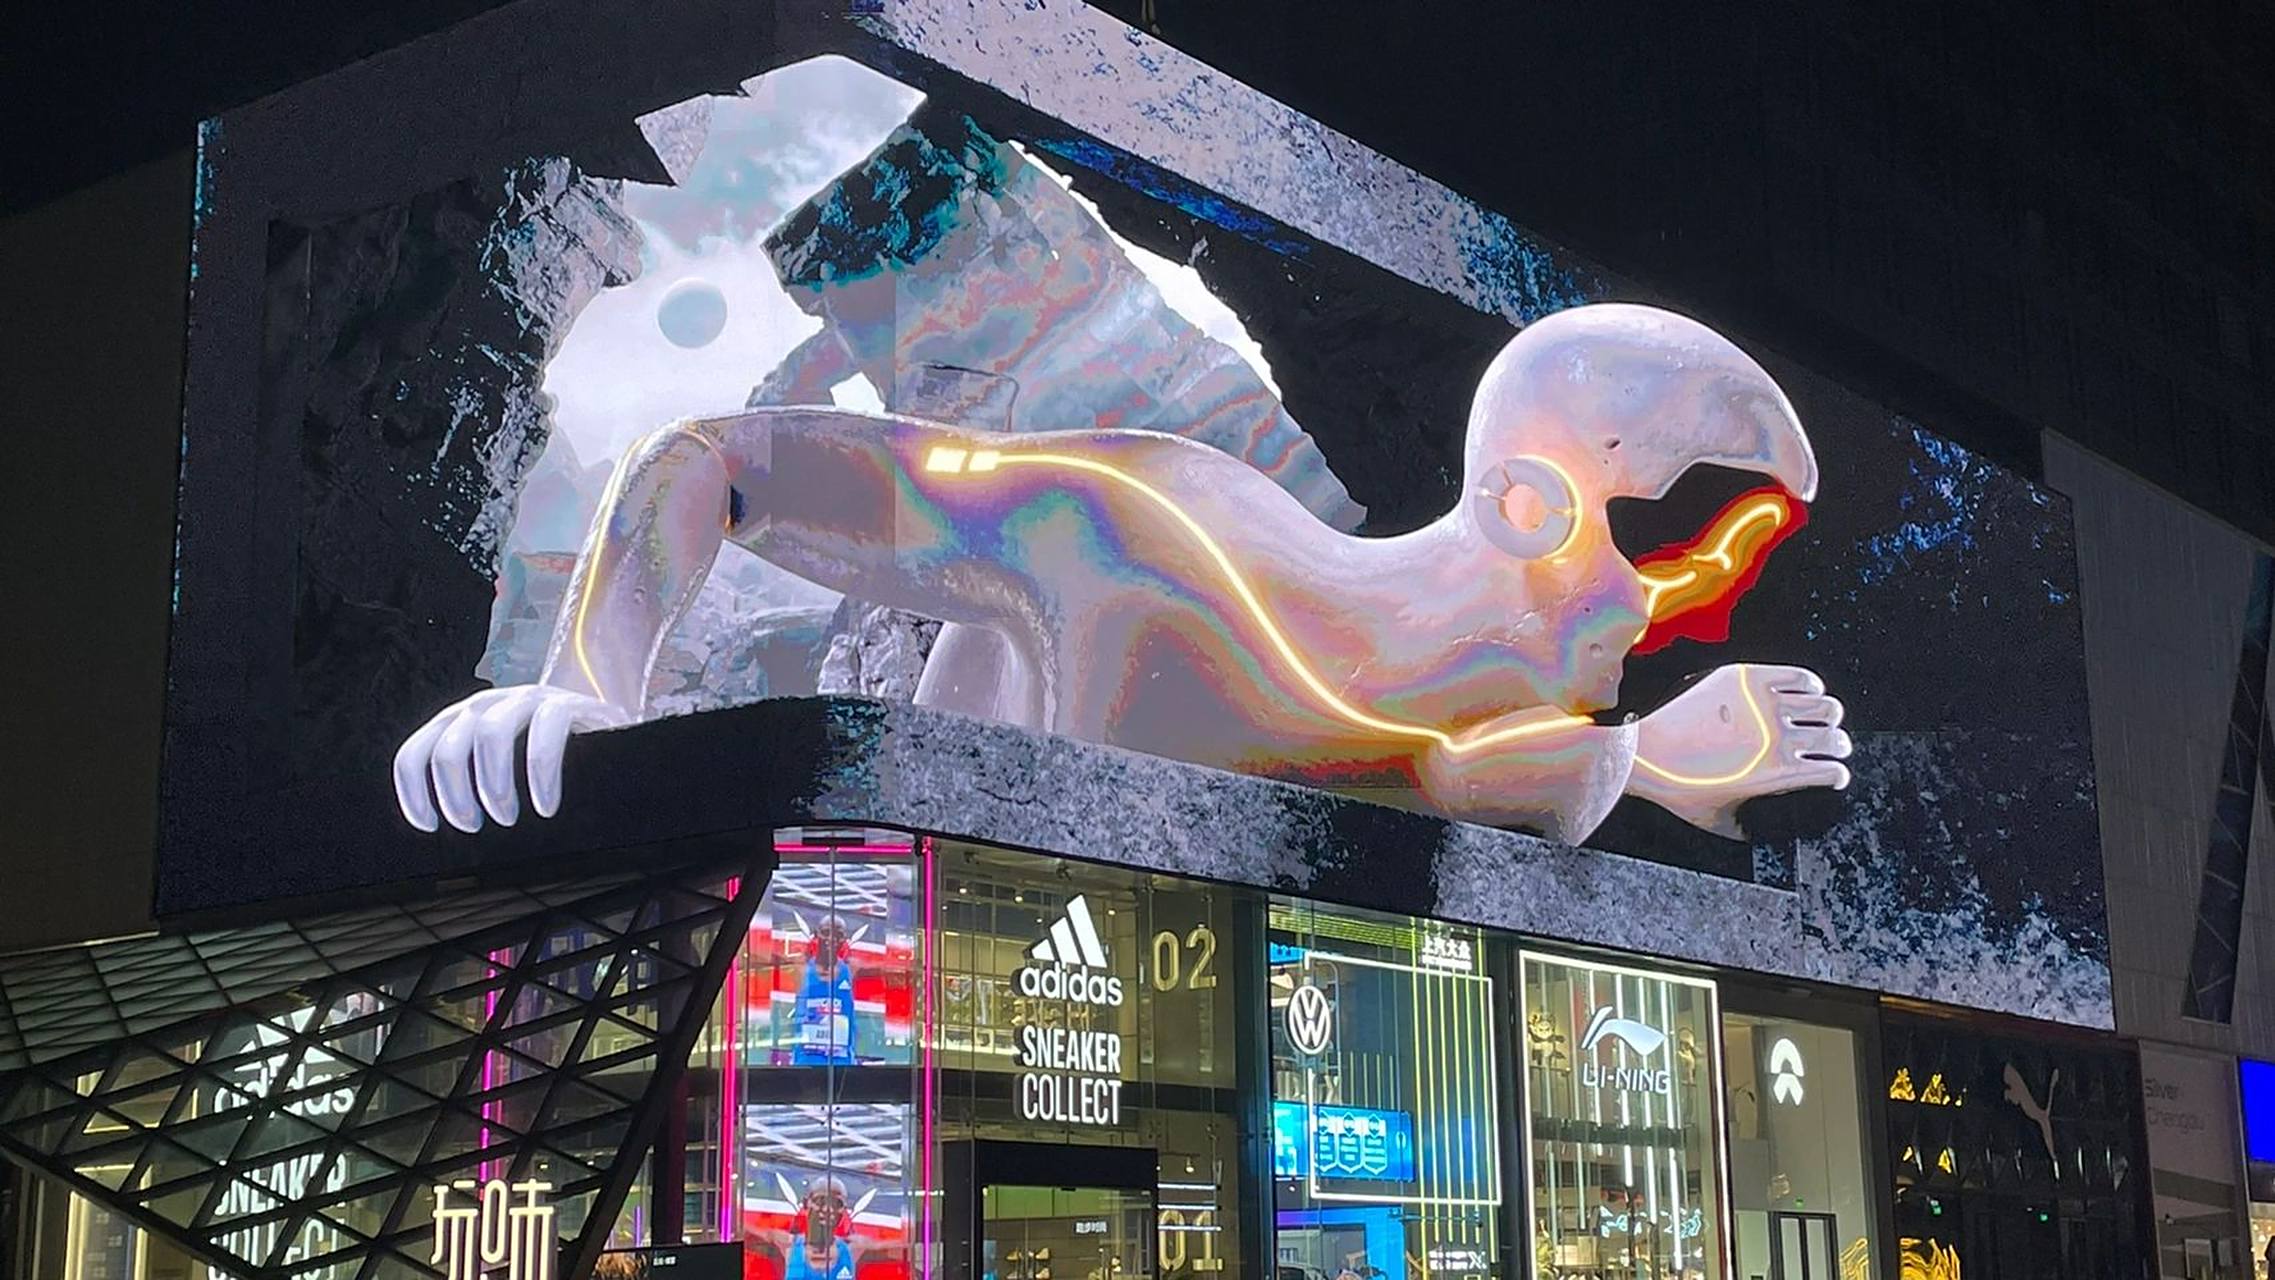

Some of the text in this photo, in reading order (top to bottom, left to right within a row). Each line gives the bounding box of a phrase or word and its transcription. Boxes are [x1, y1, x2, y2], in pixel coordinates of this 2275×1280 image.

[1020, 960, 1123, 1006] adidas
[1152, 927, 1217, 991] 02
[1022, 1024, 1121, 1074] SNEAKER
[1022, 1072, 1122, 1126] COLLECT
[1583, 1062, 1671, 1094] LI-NING
[1157, 1209, 1223, 1271] 01
